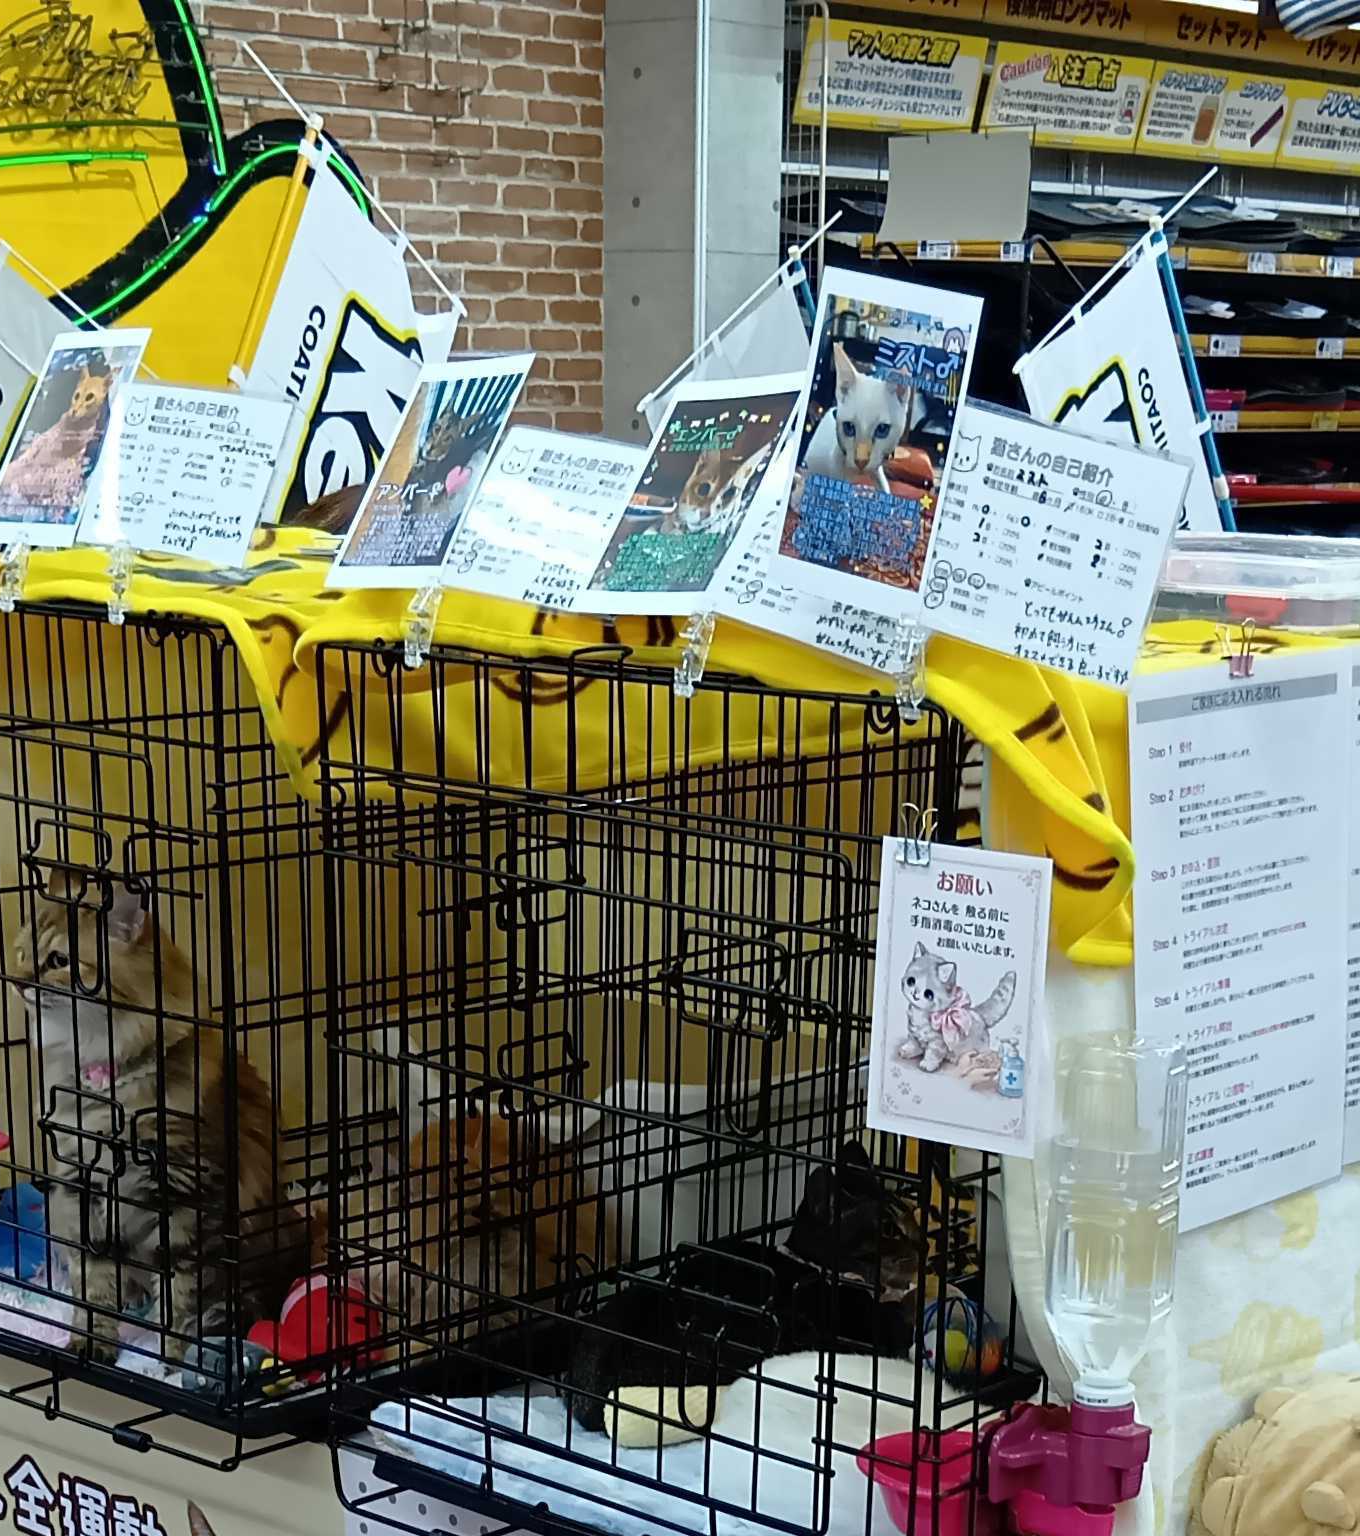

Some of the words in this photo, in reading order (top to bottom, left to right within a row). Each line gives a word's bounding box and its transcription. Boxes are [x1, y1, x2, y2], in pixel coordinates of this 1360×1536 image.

[1176, 12, 1268, 50] セットマット
[999, 53, 1053, 83] Caution
[1060, 57, 1122, 91] 注意点
[1148, 746, 1166, 760] Step
[1149, 792, 1166, 805] Step
[936, 870, 993, 897] お願い
[1151, 868, 1168, 882] Step
[911, 896, 960, 917] ネコさんを
[965, 904, 1010, 923] 触る前に
[909, 914, 1006, 941] 手指消毒のご協力を
[936, 936, 1016, 959] お願いいたします。
[1153, 939, 1170, 951] Step
[1154, 995, 1172, 1008] Step
